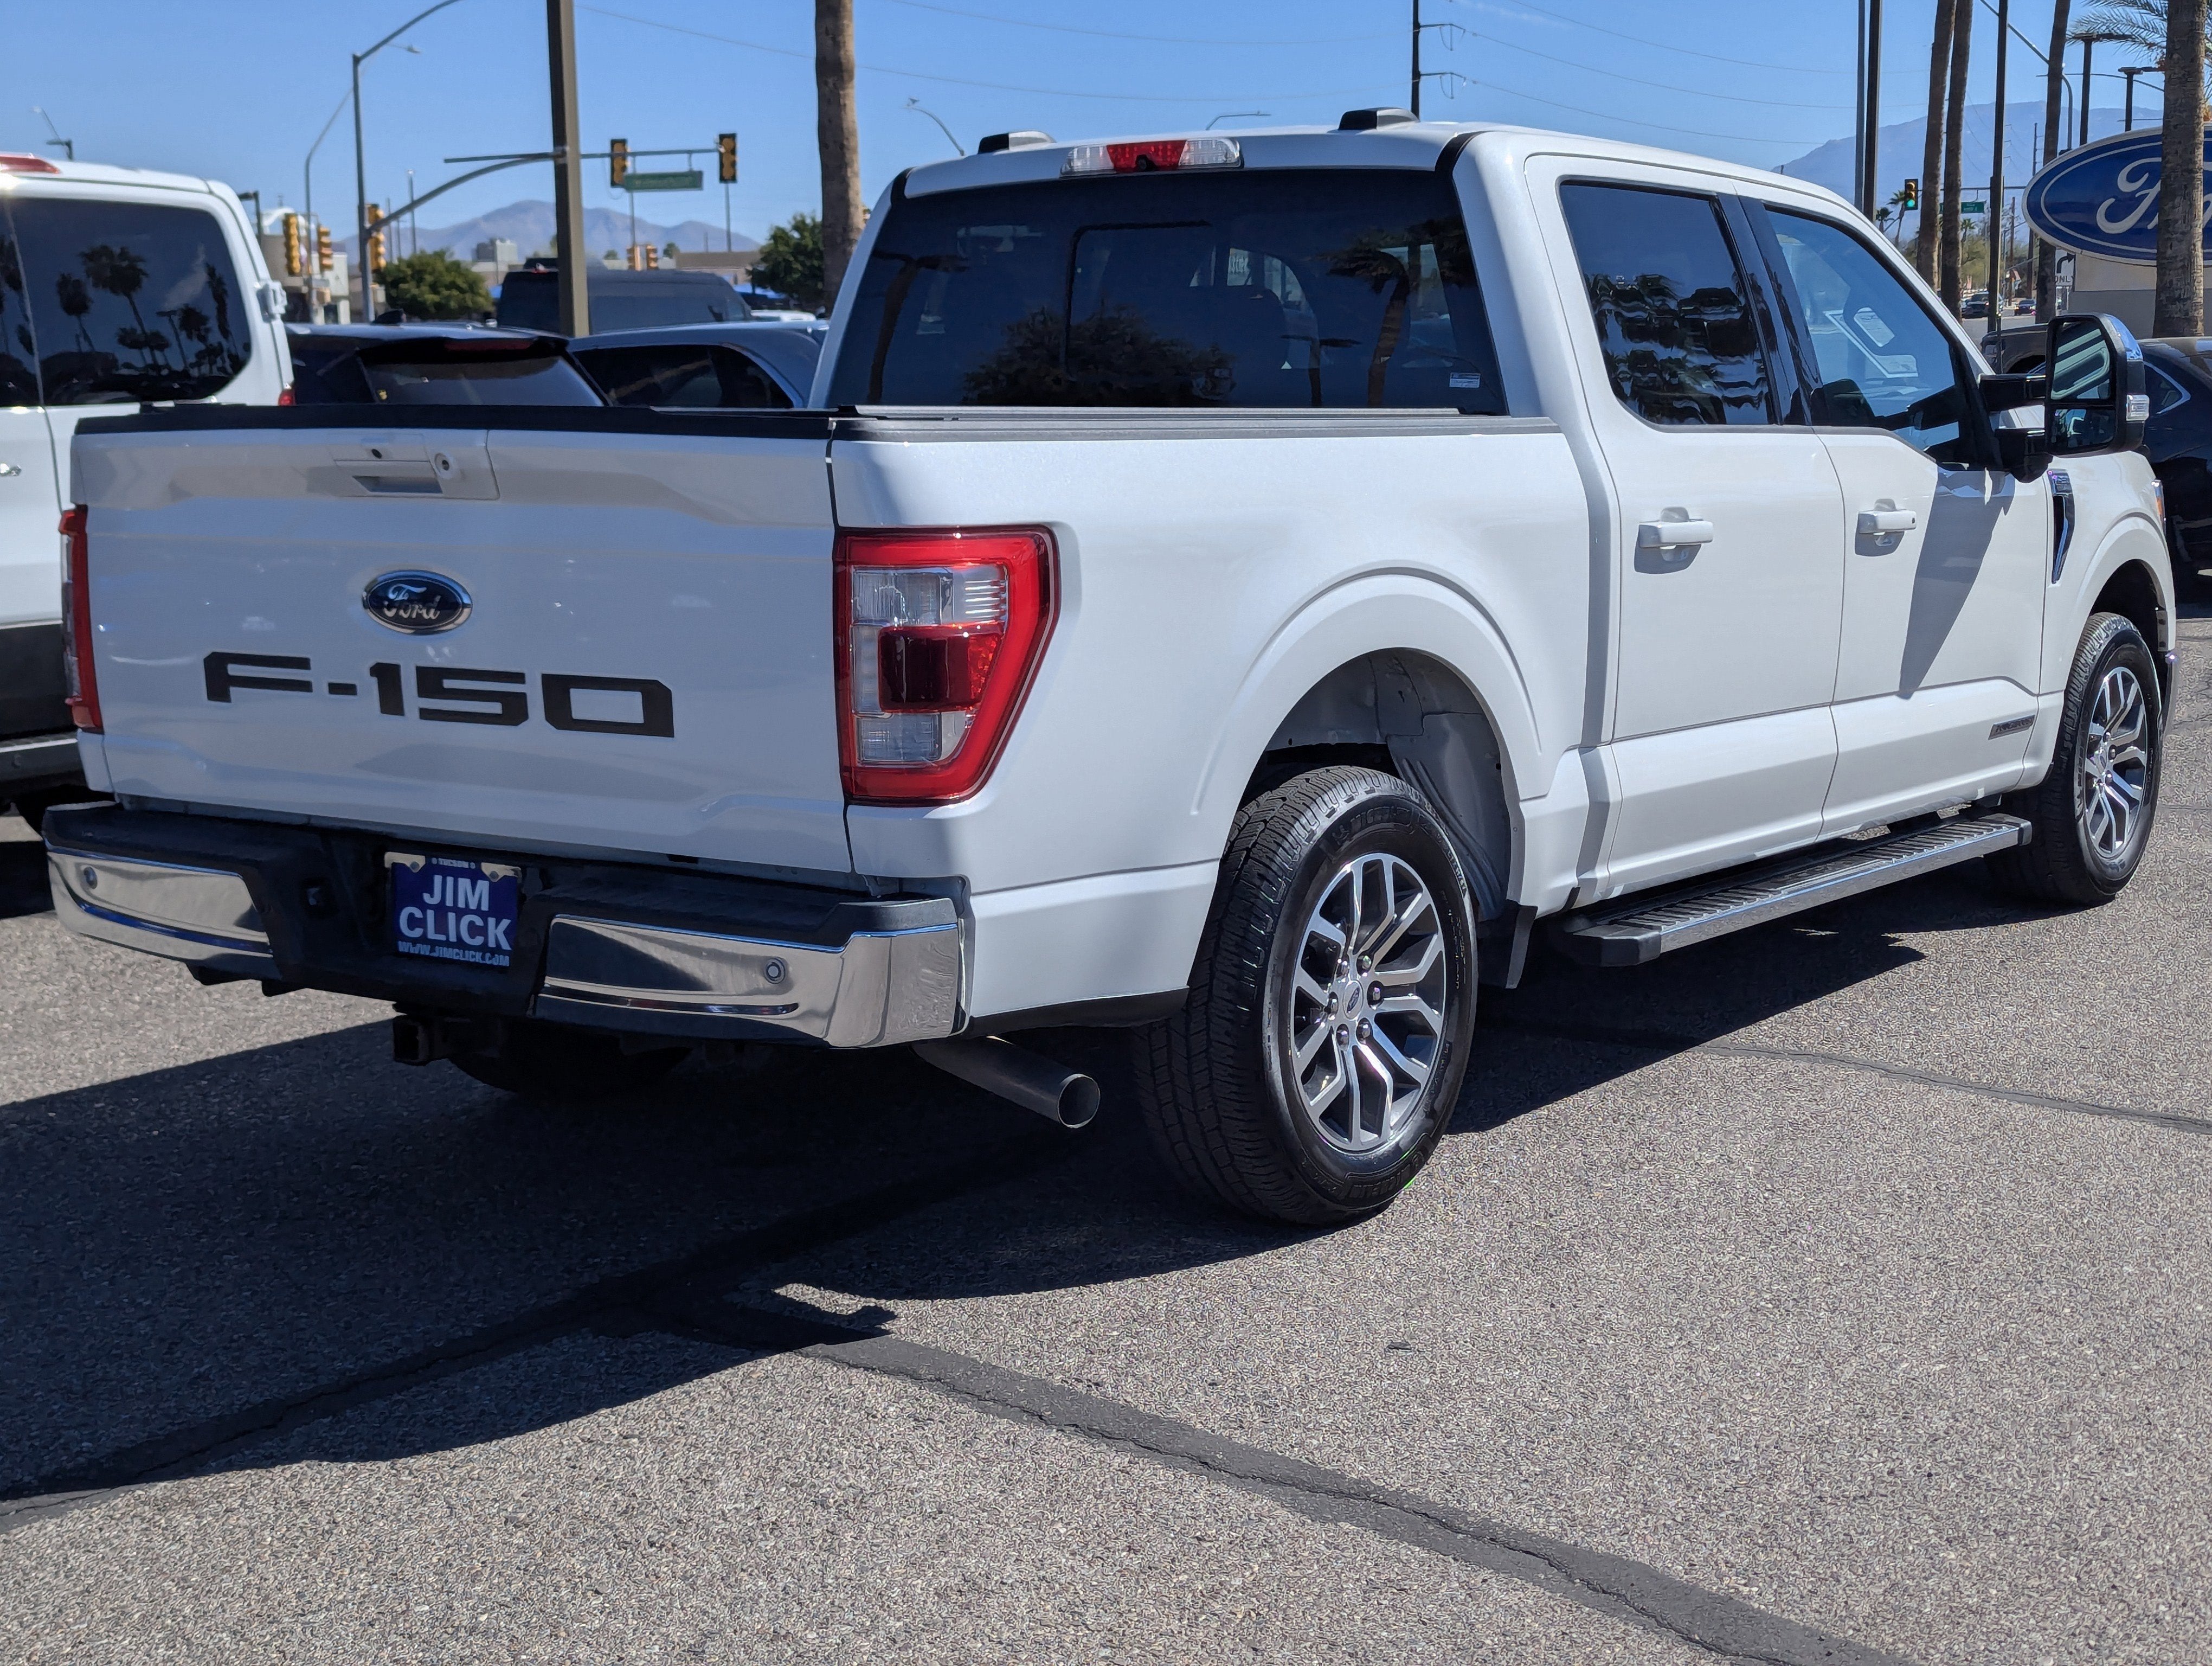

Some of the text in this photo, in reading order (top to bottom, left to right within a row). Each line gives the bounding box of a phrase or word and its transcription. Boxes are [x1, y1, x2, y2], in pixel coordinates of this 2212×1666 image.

[383, 583, 441, 619] Ford
[204, 651, 675, 738] F-150
[423, 874, 490, 911] JIM
[399, 906, 513, 951] CLICK
[397, 940, 510, 967] WWW.JIMCLICK.COM
